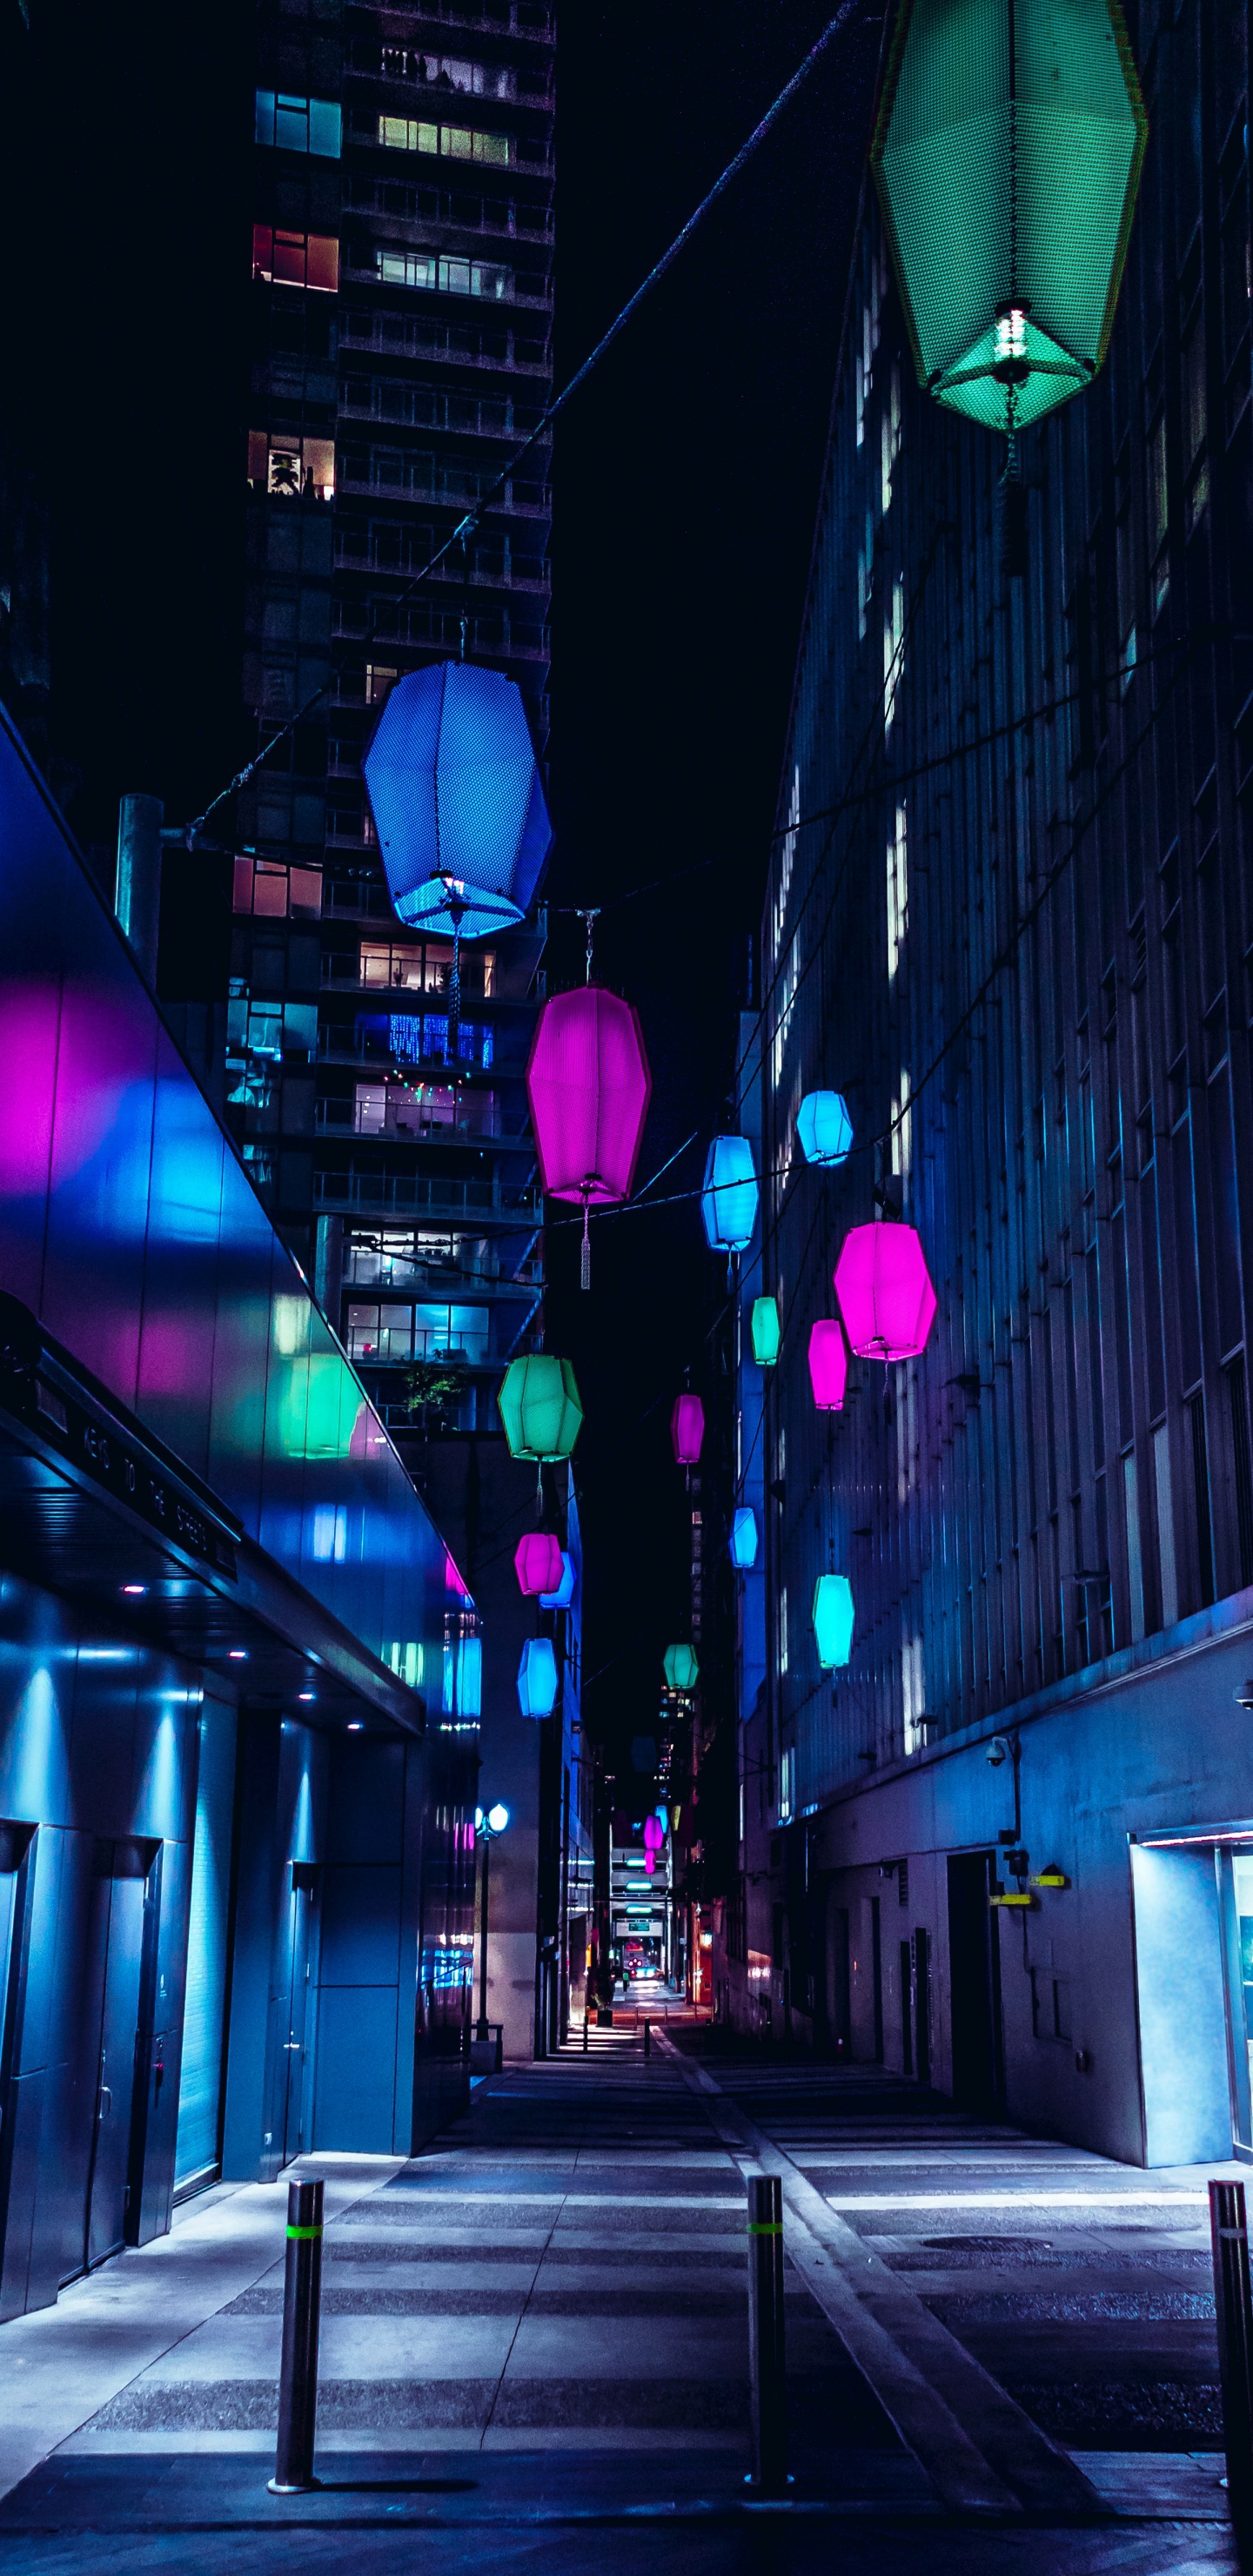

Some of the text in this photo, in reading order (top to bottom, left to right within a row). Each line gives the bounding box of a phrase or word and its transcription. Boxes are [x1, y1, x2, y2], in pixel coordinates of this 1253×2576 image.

[84, 1426, 109, 1468] KEYS
[124, 1458, 135, 1491] TO
[150, 1480, 165, 1515] THE
